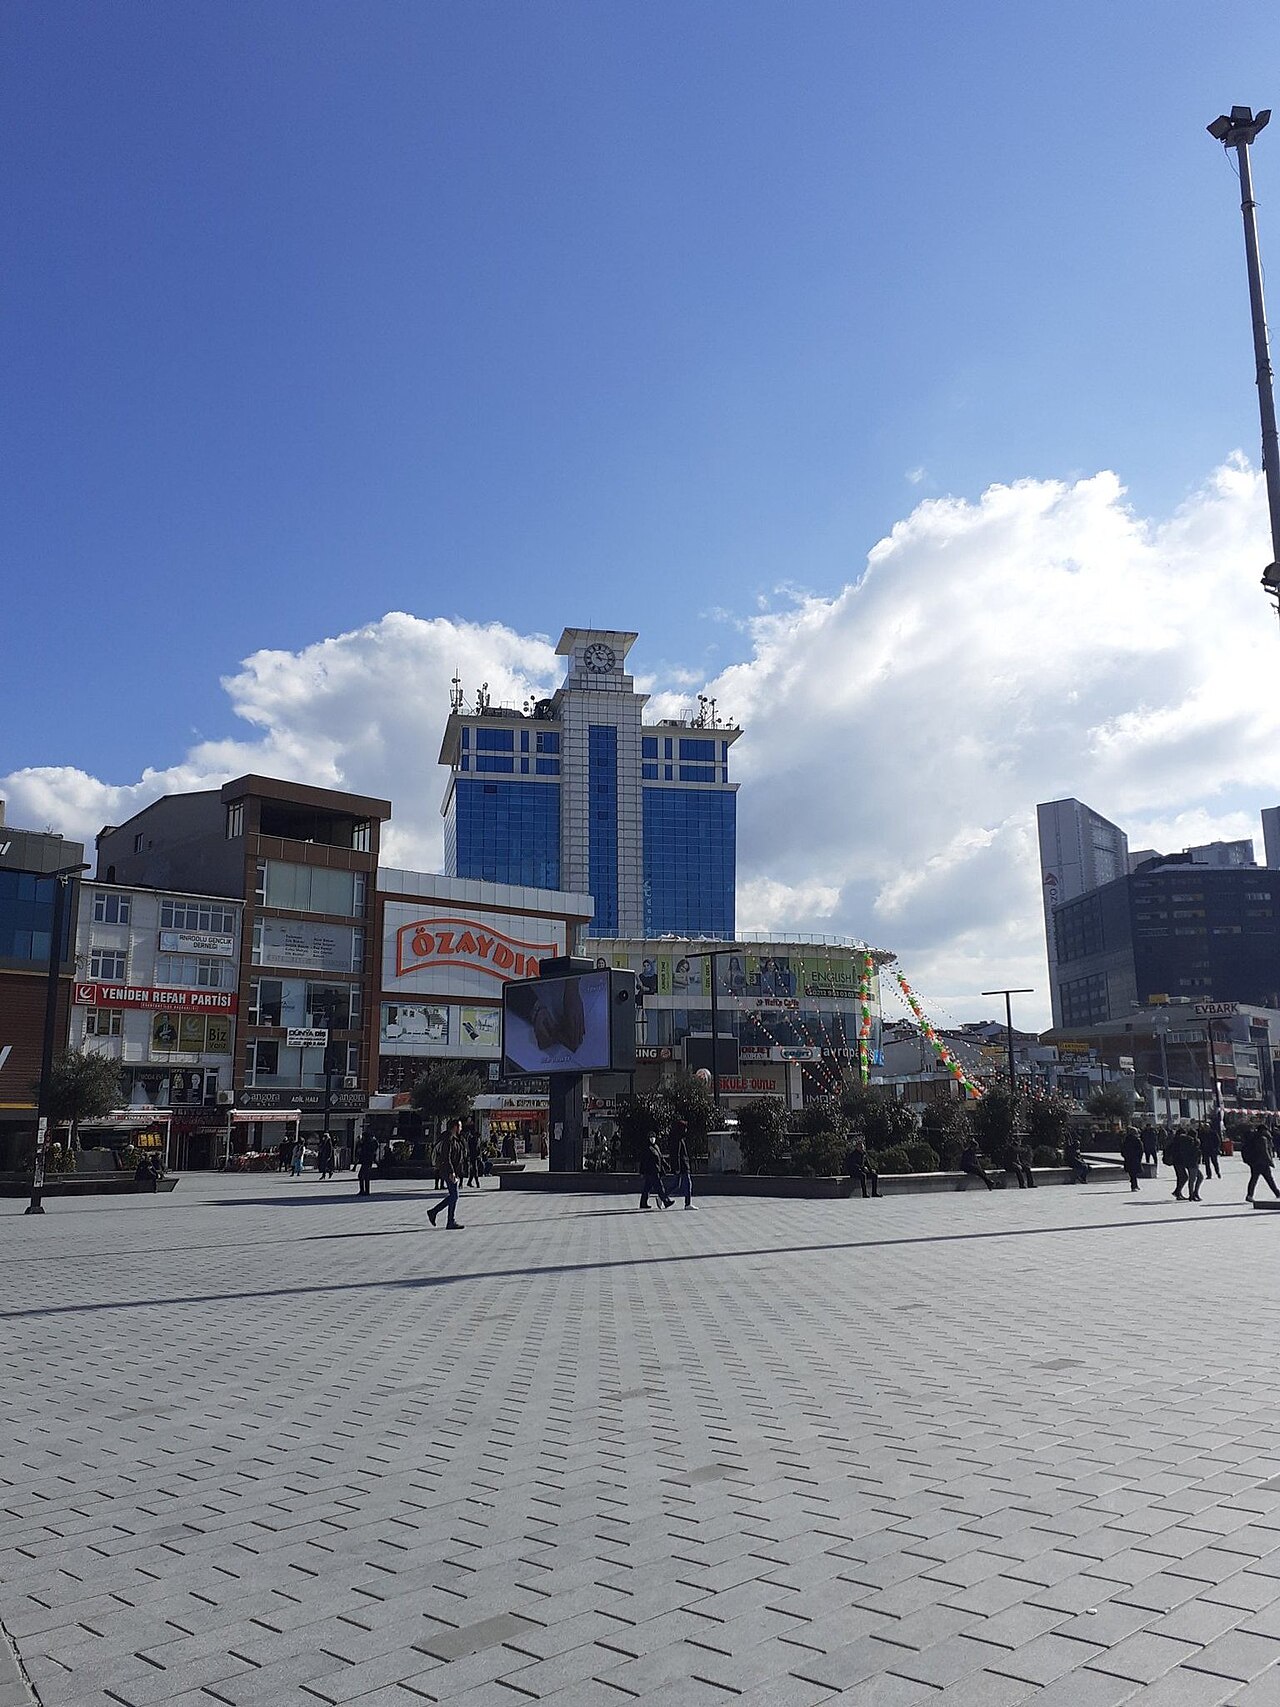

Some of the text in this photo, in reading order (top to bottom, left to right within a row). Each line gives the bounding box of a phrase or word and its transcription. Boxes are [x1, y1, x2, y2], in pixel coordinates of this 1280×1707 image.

[411, 927, 541, 978] ÖZAYDIN
[811, 971, 851, 984] ENGLISH
[102, 986, 149, 1002] YENİDEN
[152, 993, 186, 1004] REFAH
[191, 992, 232, 1007] PARTİSİ
[1195, 1003, 1239, 1015] EVBARK
[209, 1029, 227, 1041] Biz
[251, 1093, 280, 1103] angora
